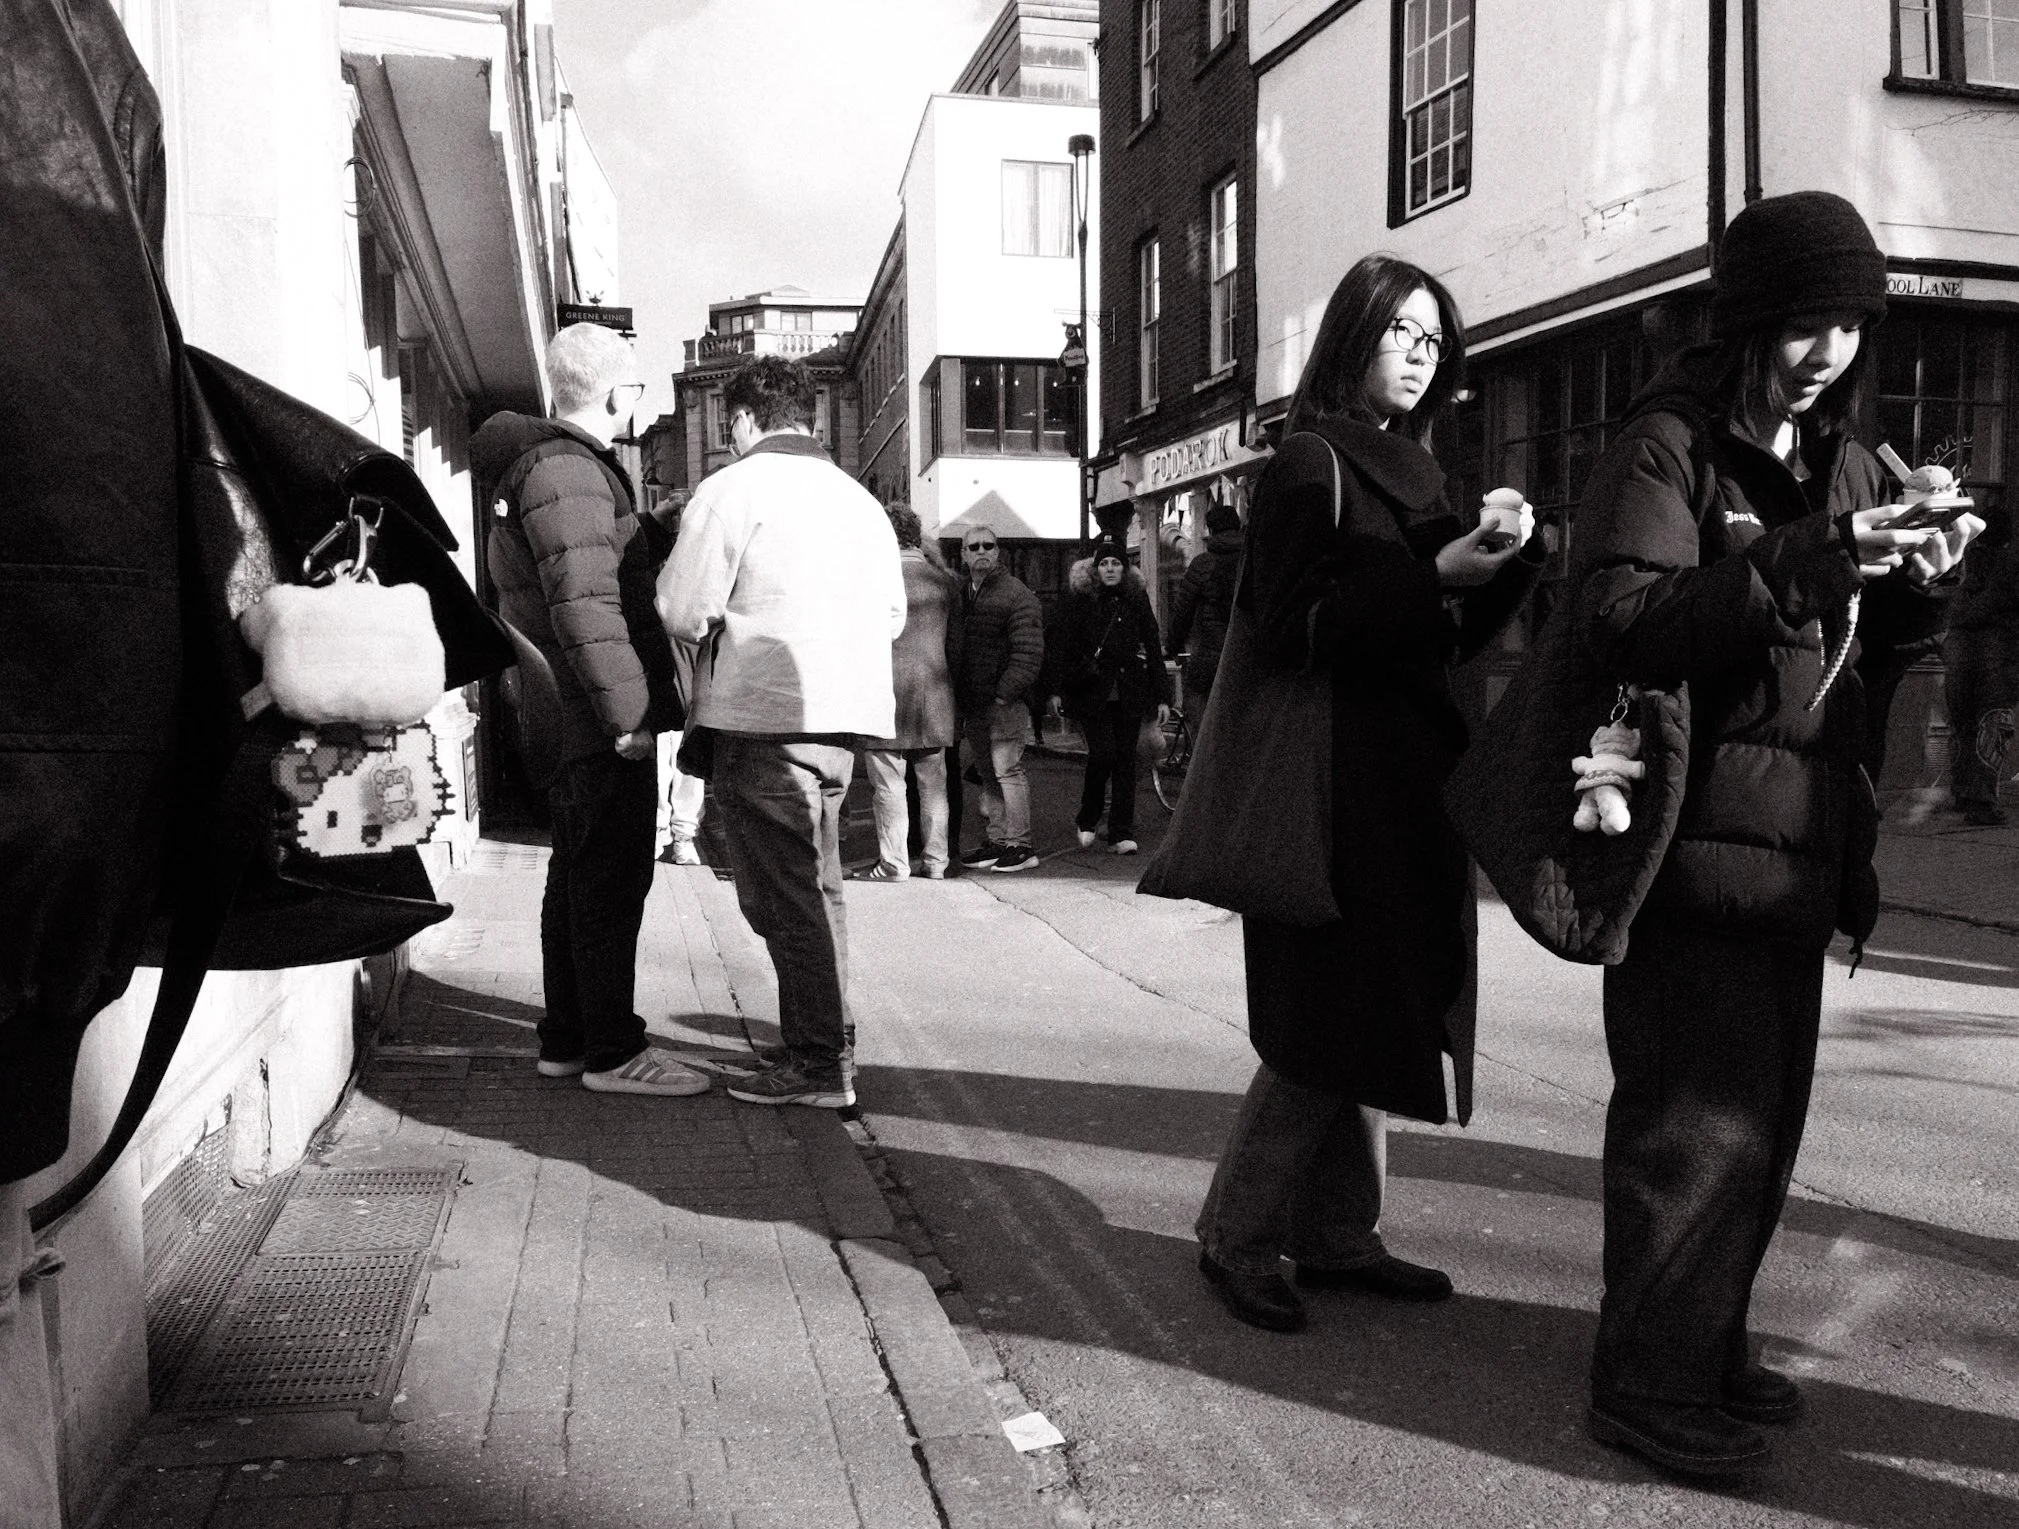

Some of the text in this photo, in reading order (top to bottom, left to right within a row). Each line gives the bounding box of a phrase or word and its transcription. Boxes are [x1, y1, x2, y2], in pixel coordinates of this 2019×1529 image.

[1919, 276, 1960, 297] LANE
[565, 311, 626, 322] GREENE KING
[1150, 427, 1230, 485] PODAROK
